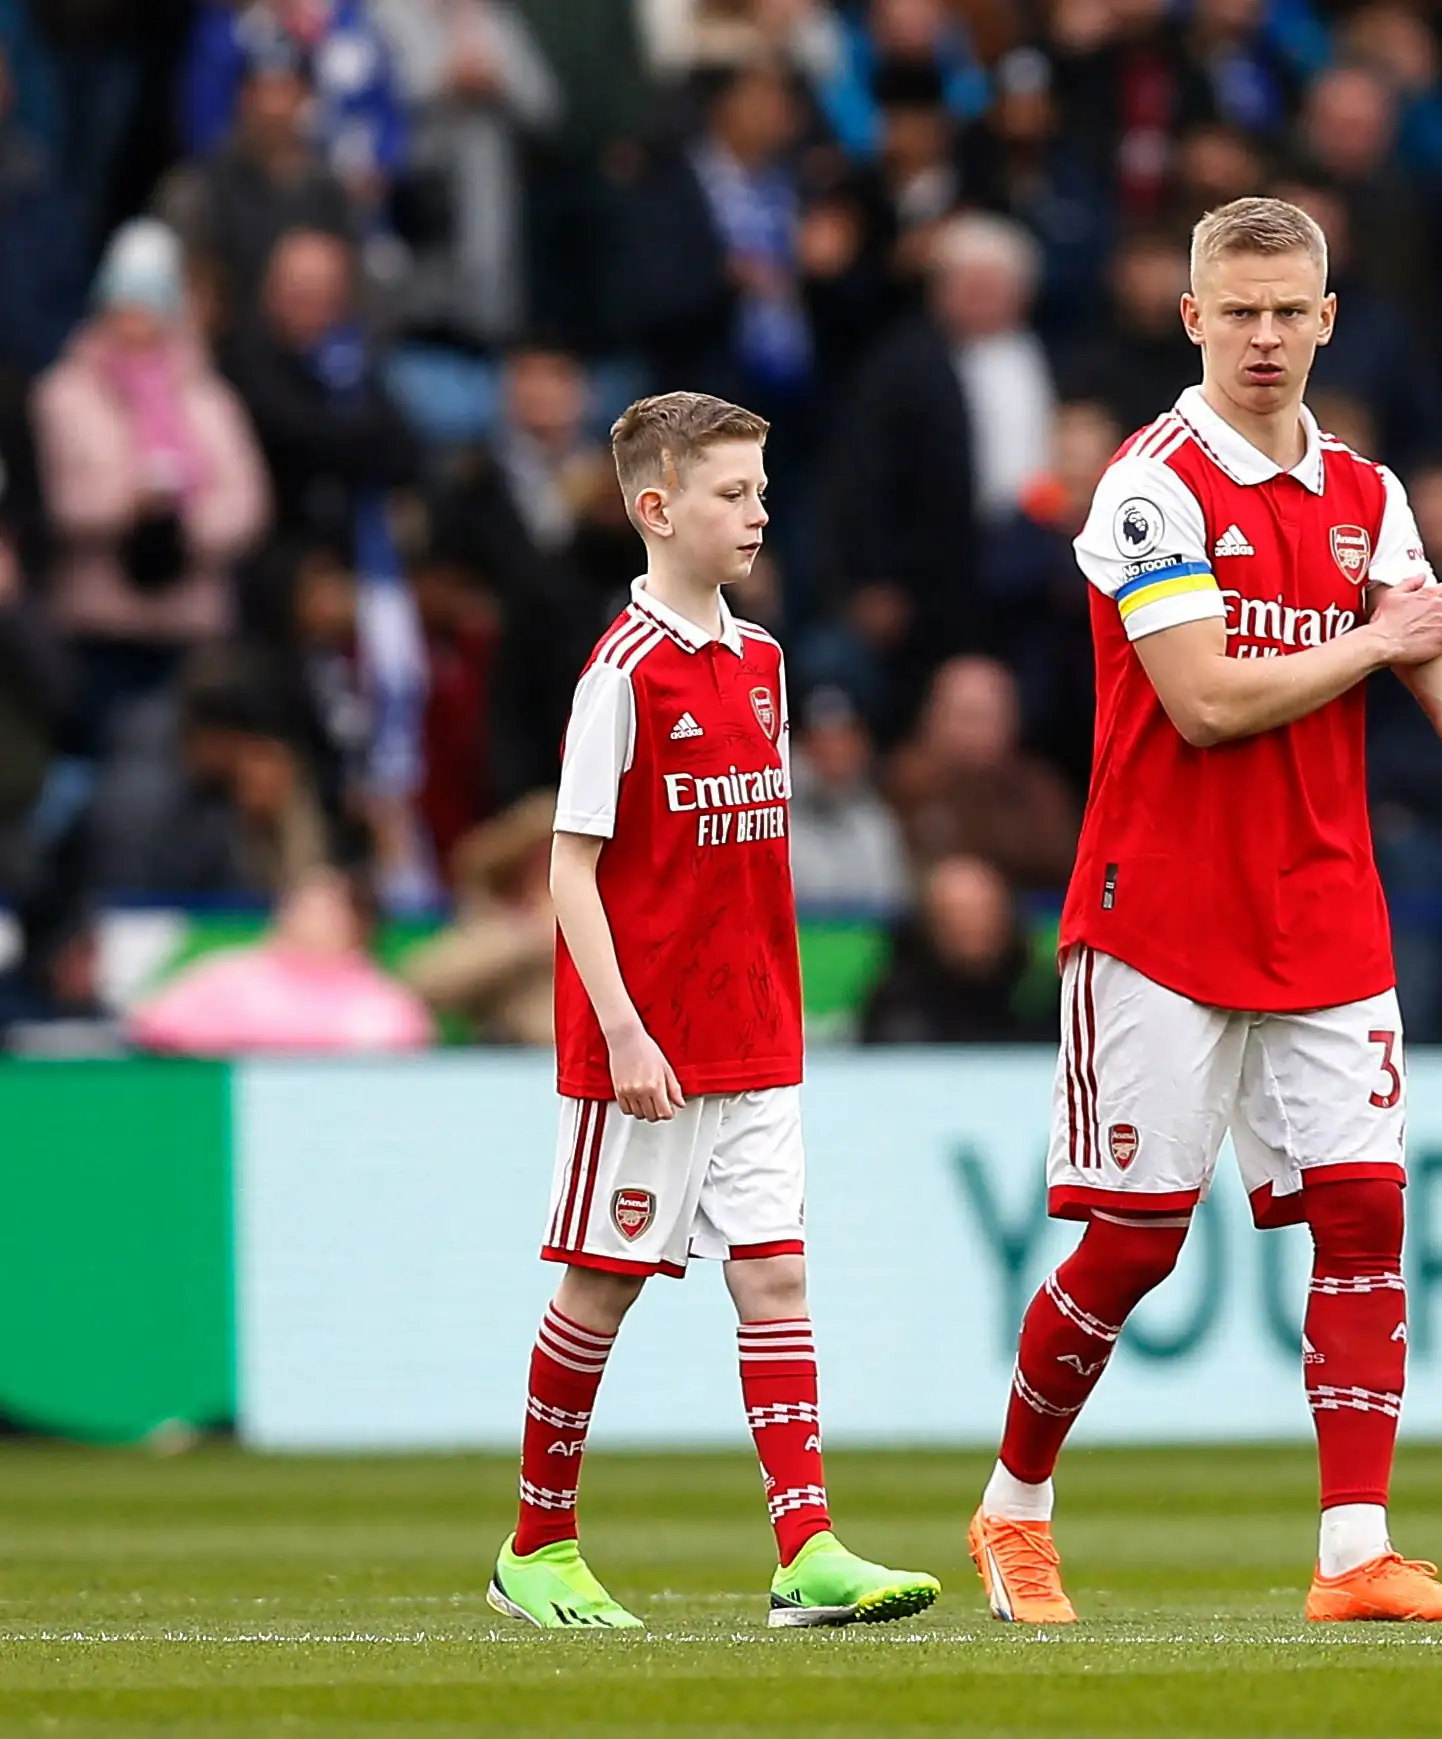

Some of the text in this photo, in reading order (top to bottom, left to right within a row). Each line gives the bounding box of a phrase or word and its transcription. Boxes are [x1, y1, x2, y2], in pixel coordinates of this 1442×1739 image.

[1215, 545, 1254, 556] adidas
[1141, 556, 1177, 574] room
[670, 728, 703, 740] adidas
[697, 806, 785, 846] FLY BETTER
[547, 1440, 585, 1456] AF
